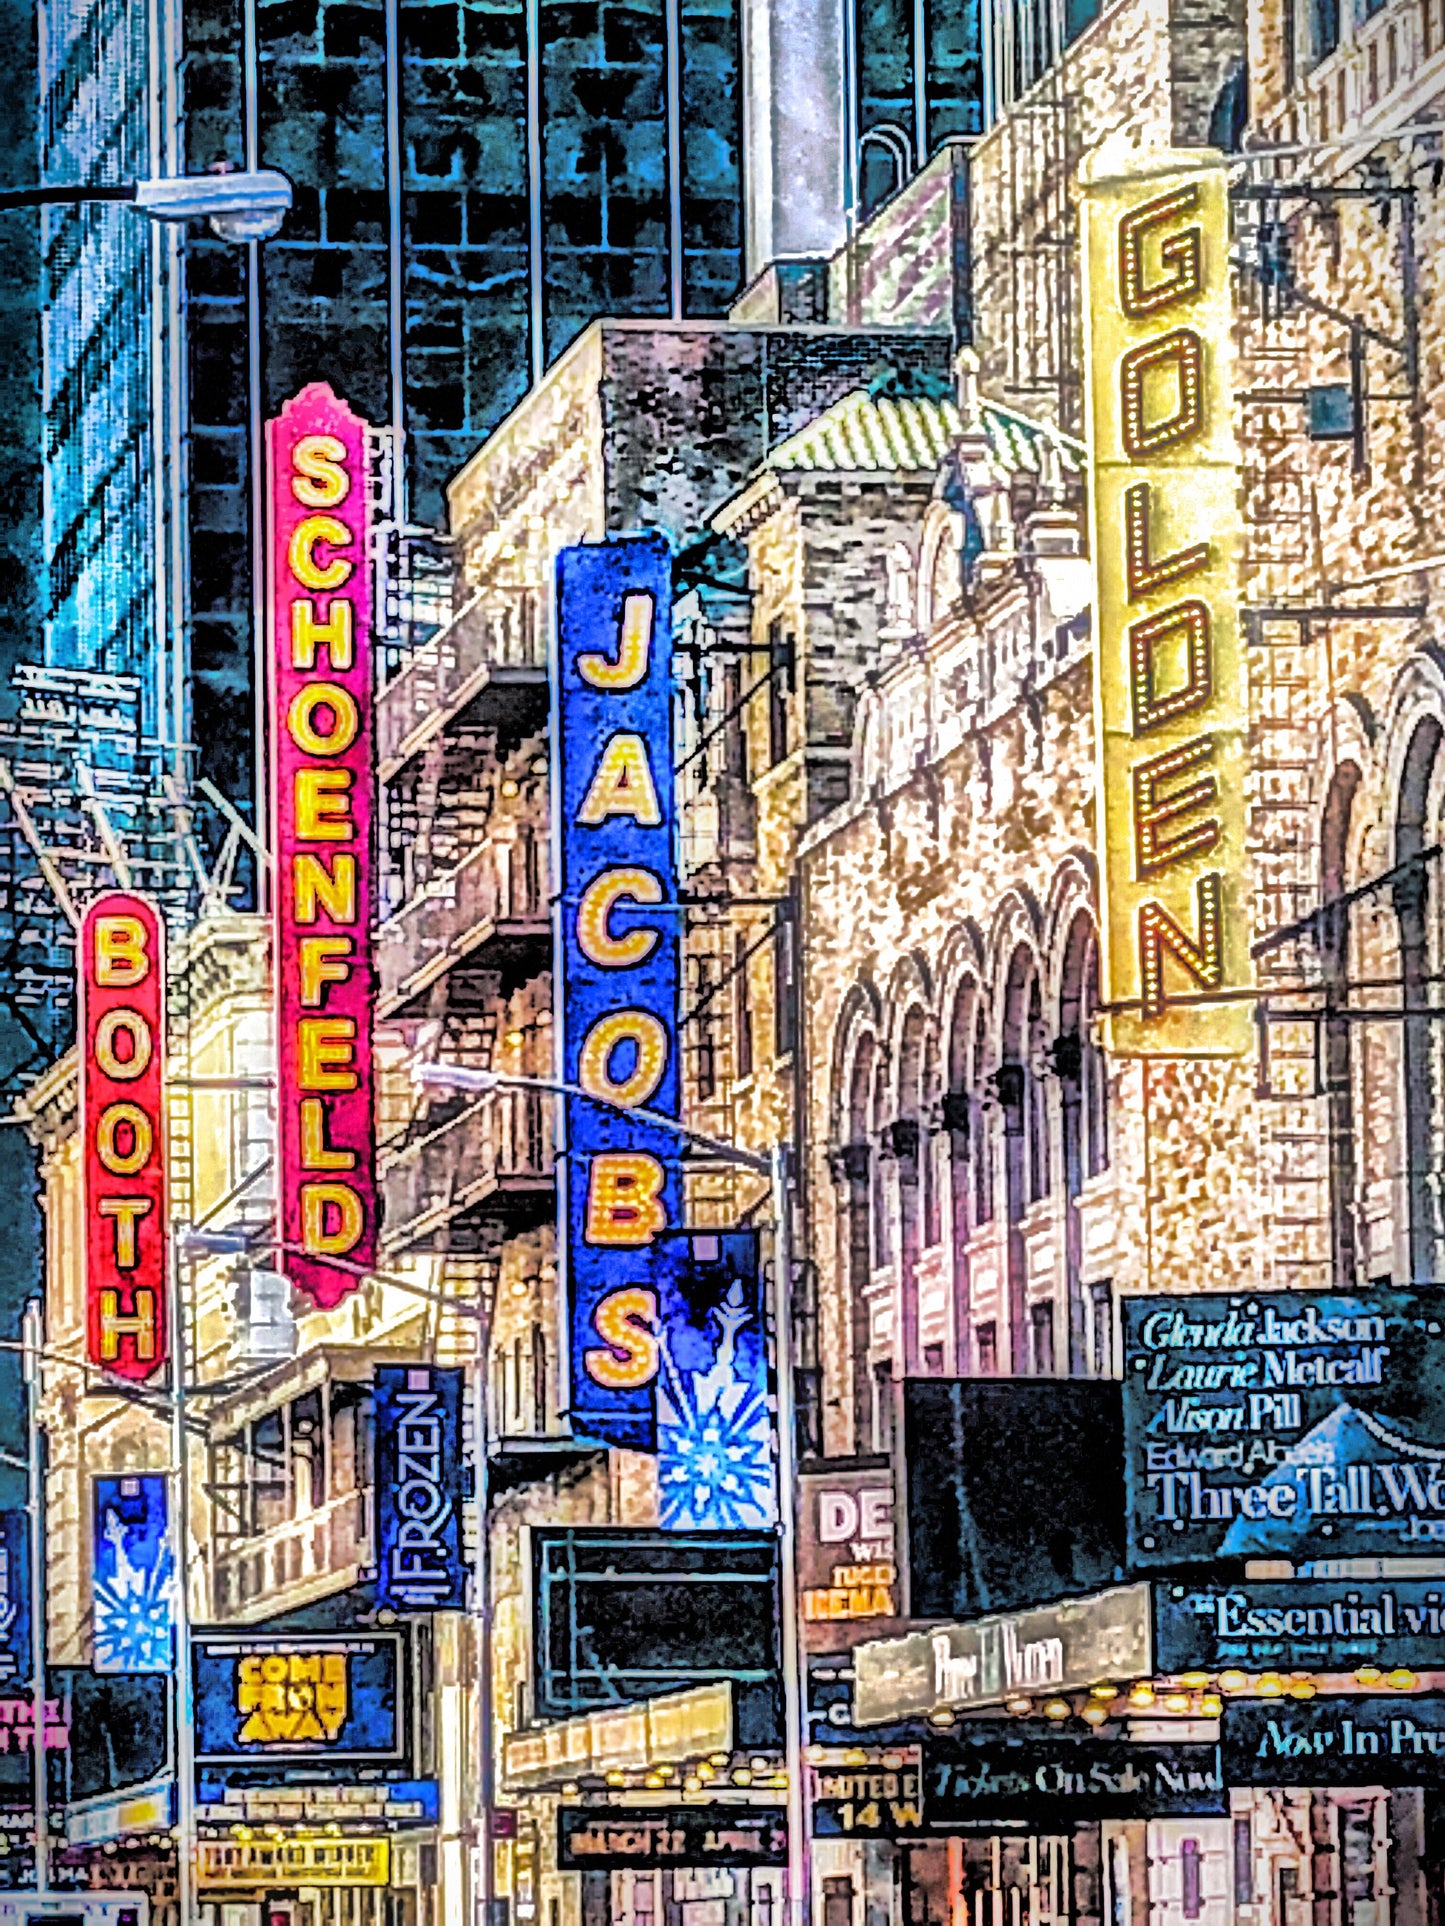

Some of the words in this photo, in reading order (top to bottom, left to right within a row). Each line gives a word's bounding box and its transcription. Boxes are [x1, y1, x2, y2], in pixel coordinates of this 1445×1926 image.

[1119, 181, 1221, 1020] GOLDEN
[287, 433, 364, 1256] SCHOENFELD
[577, 593, 668, 1388] JACOBS
[94, 915, 154, 1360] BOOTH
[1146, 1351, 1259, 1390] Laurie
[1262, 1346, 1391, 1387] Metcalf
[1257, 1307, 1386, 1346] Jackson
[1250, 1393, 1301, 1430] Pill
[391, 1393, 452, 1580] FROZEN
[1147, 1470, 1297, 1520] Three
[1295, 1465, 1377, 1514] Tall
[1341, 1719, 1379, 1755] In
